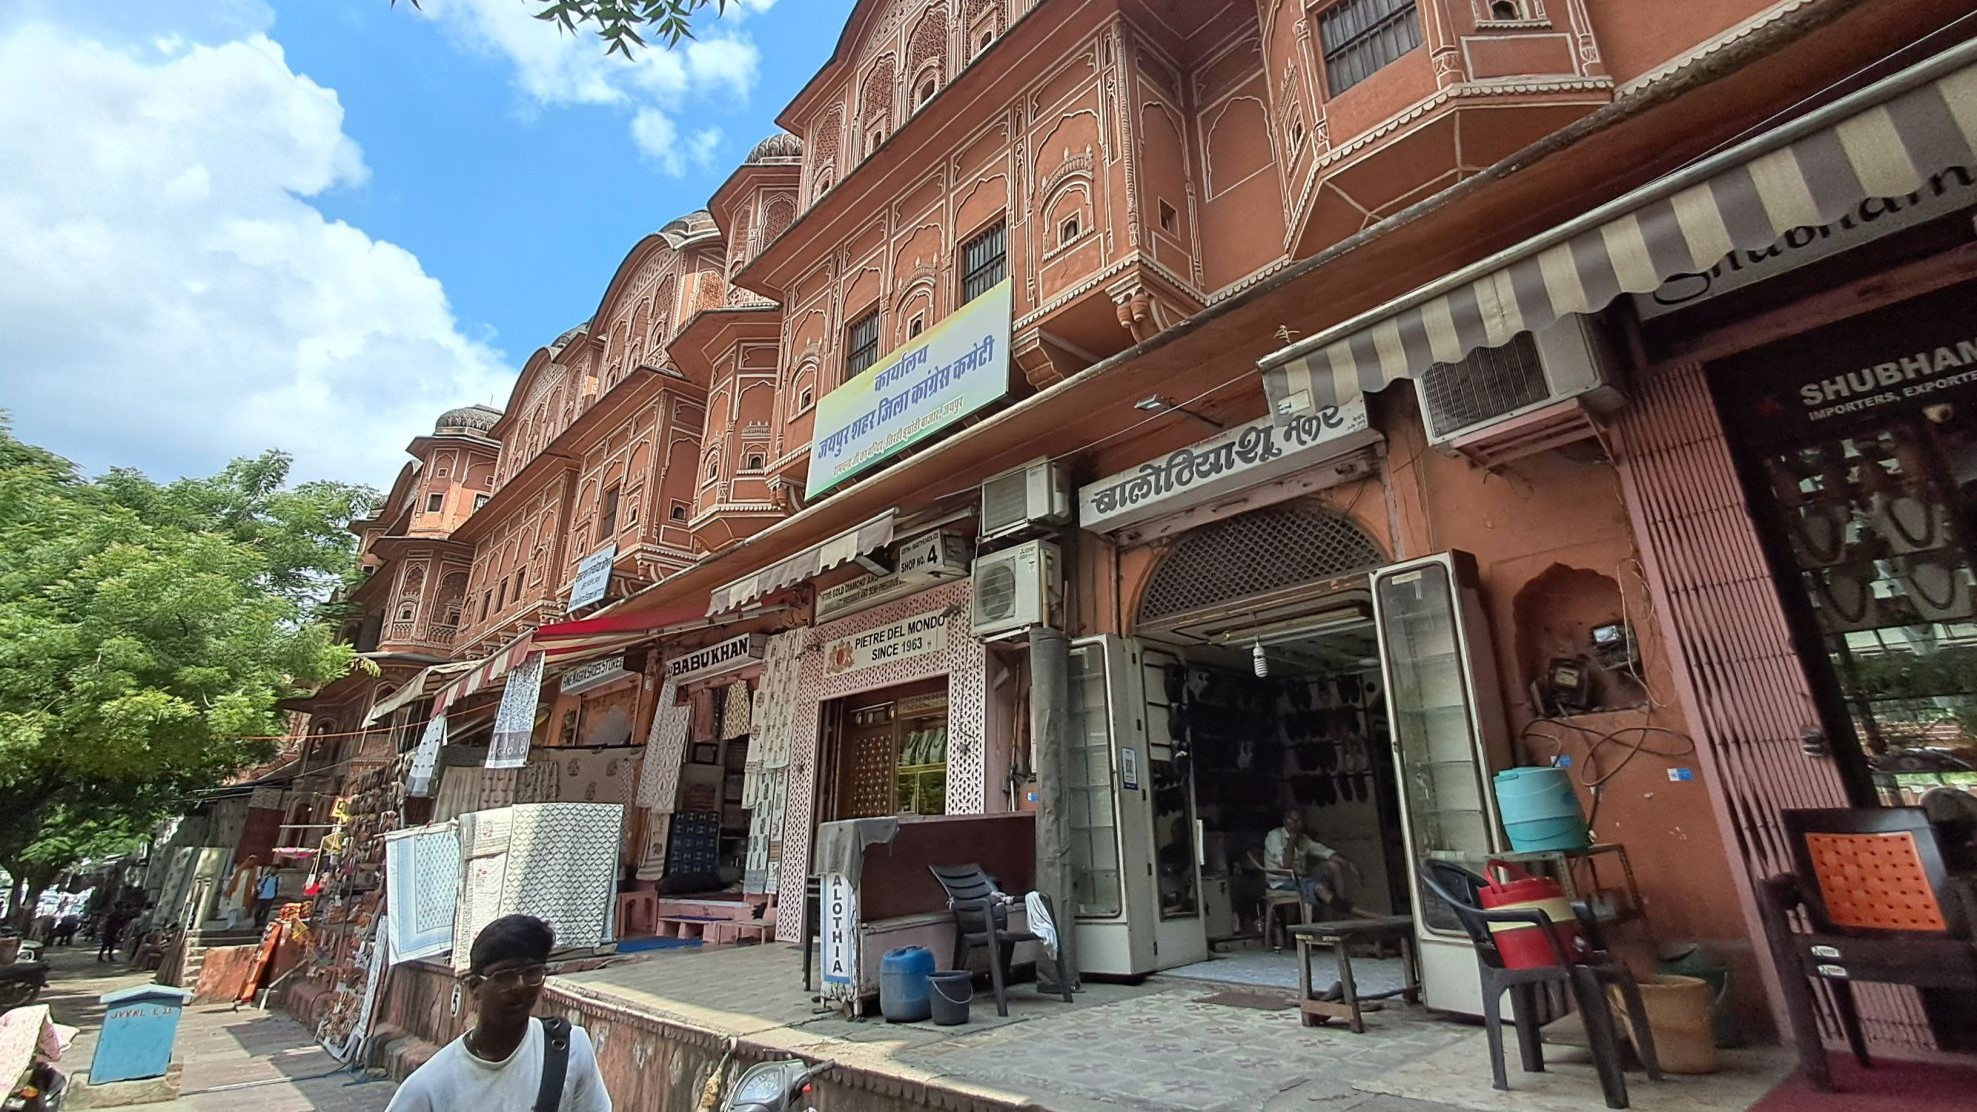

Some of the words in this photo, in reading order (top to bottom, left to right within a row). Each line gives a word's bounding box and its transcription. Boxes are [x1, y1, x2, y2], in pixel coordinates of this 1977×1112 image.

[874, 344, 930, 391] कार्यालय
[818, 423, 851, 459] जयपुर
[851, 410, 877, 439] शहर
[877, 389, 910, 427] जिला
[911, 365, 952, 404] कांग्रेस
[952, 335, 995, 380] कमेटी
[1808, 391, 1902, 421] IMPORTERS,
[901, 559, 915, 573] SHOP
[927, 544, 938, 564] 4
[855, 630, 885, 650] PIETRE
[887, 625, 905, 640] DEL
[908, 615, 945, 635] MONDO
[872, 643, 899, 661] SINCE
[902, 637, 922, 653] 1963
